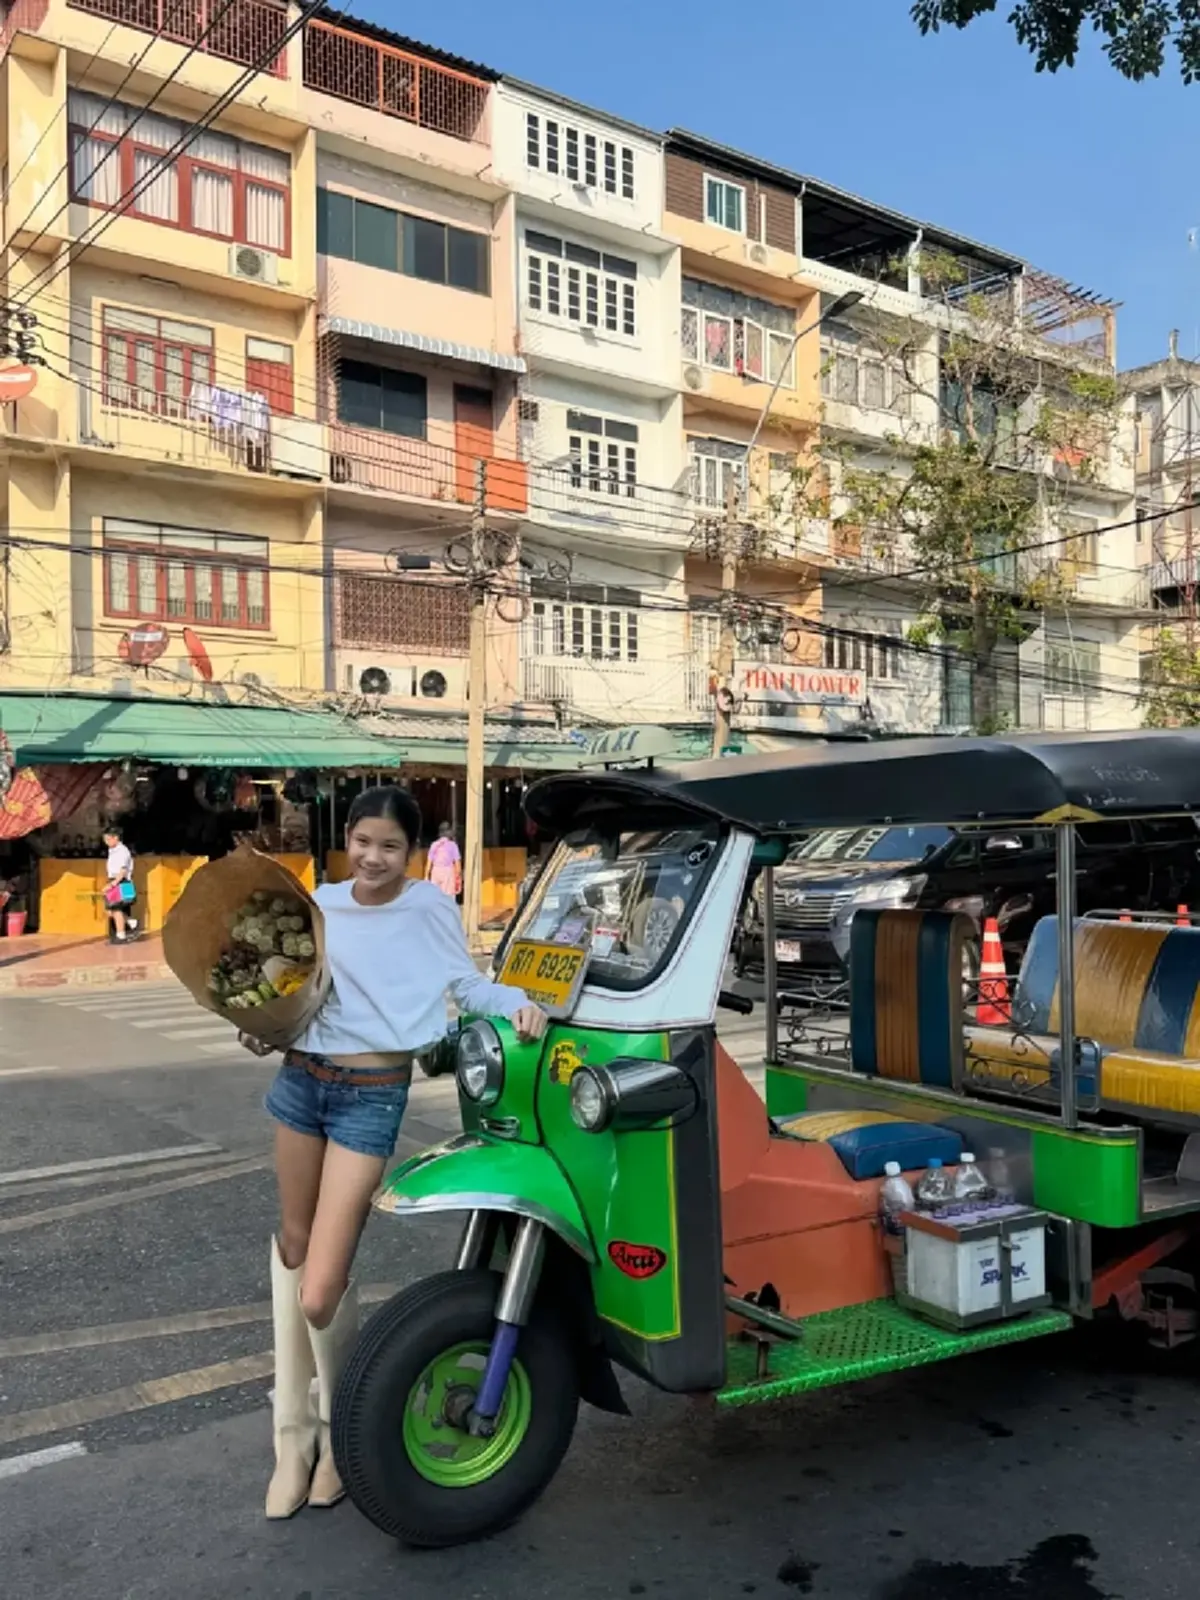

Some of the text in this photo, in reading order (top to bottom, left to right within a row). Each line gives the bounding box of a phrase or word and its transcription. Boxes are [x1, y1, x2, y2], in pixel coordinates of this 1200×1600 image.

[743, 669, 861, 695] THAI FLOWER
[588, 729, 640, 755] TAXI
[536, 951, 583, 984] 6925
